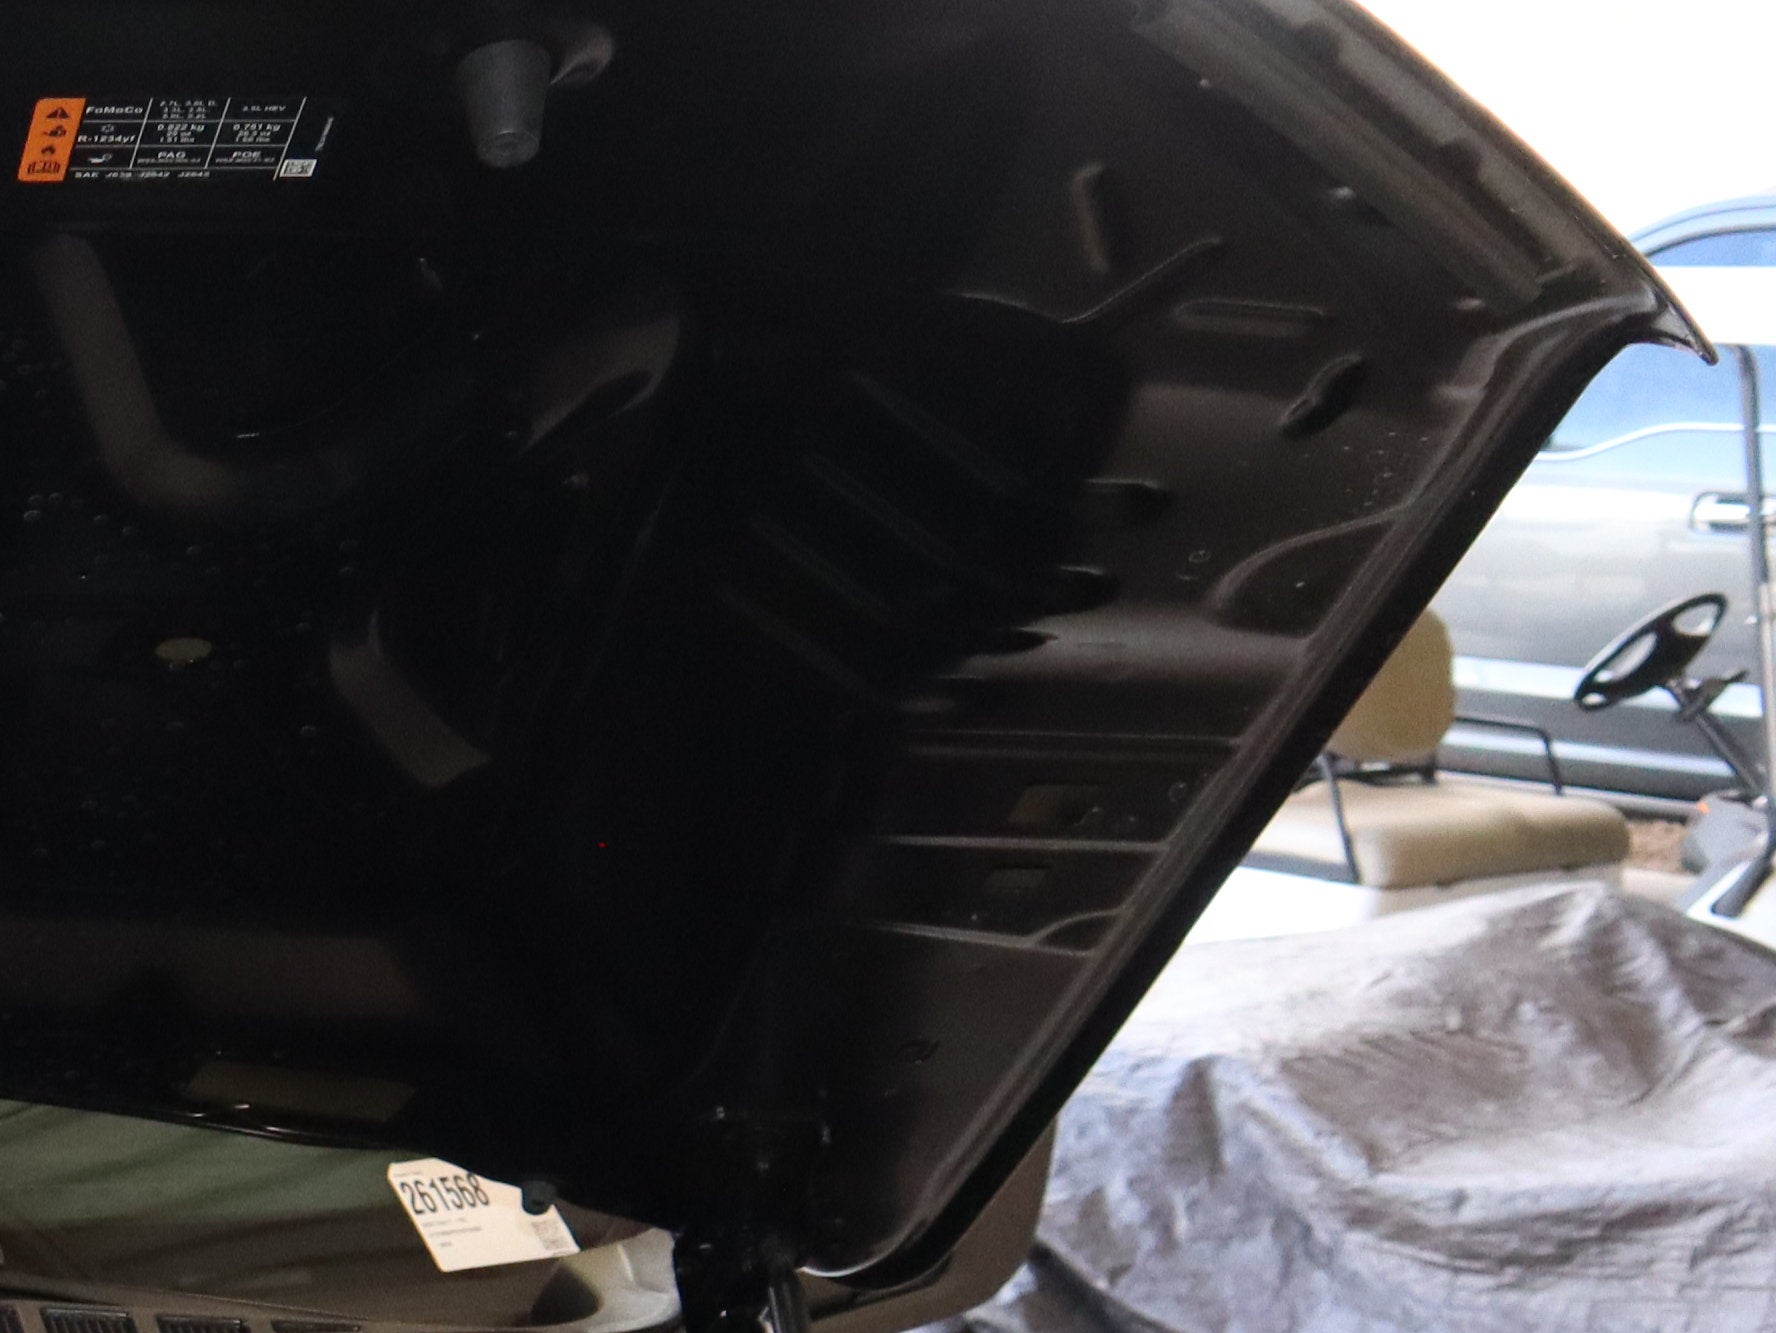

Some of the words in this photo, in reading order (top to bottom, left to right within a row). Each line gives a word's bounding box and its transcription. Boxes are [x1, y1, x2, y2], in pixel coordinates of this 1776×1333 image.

[85, 106, 144, 115] FoMoCo
[190, 123, 205, 132] kg
[266, 124, 282, 133] kg
[77, 134, 136, 144] R-1234yf
[157, 151, 186, 159] PAG
[399, 1172, 490, 1215] 261568
